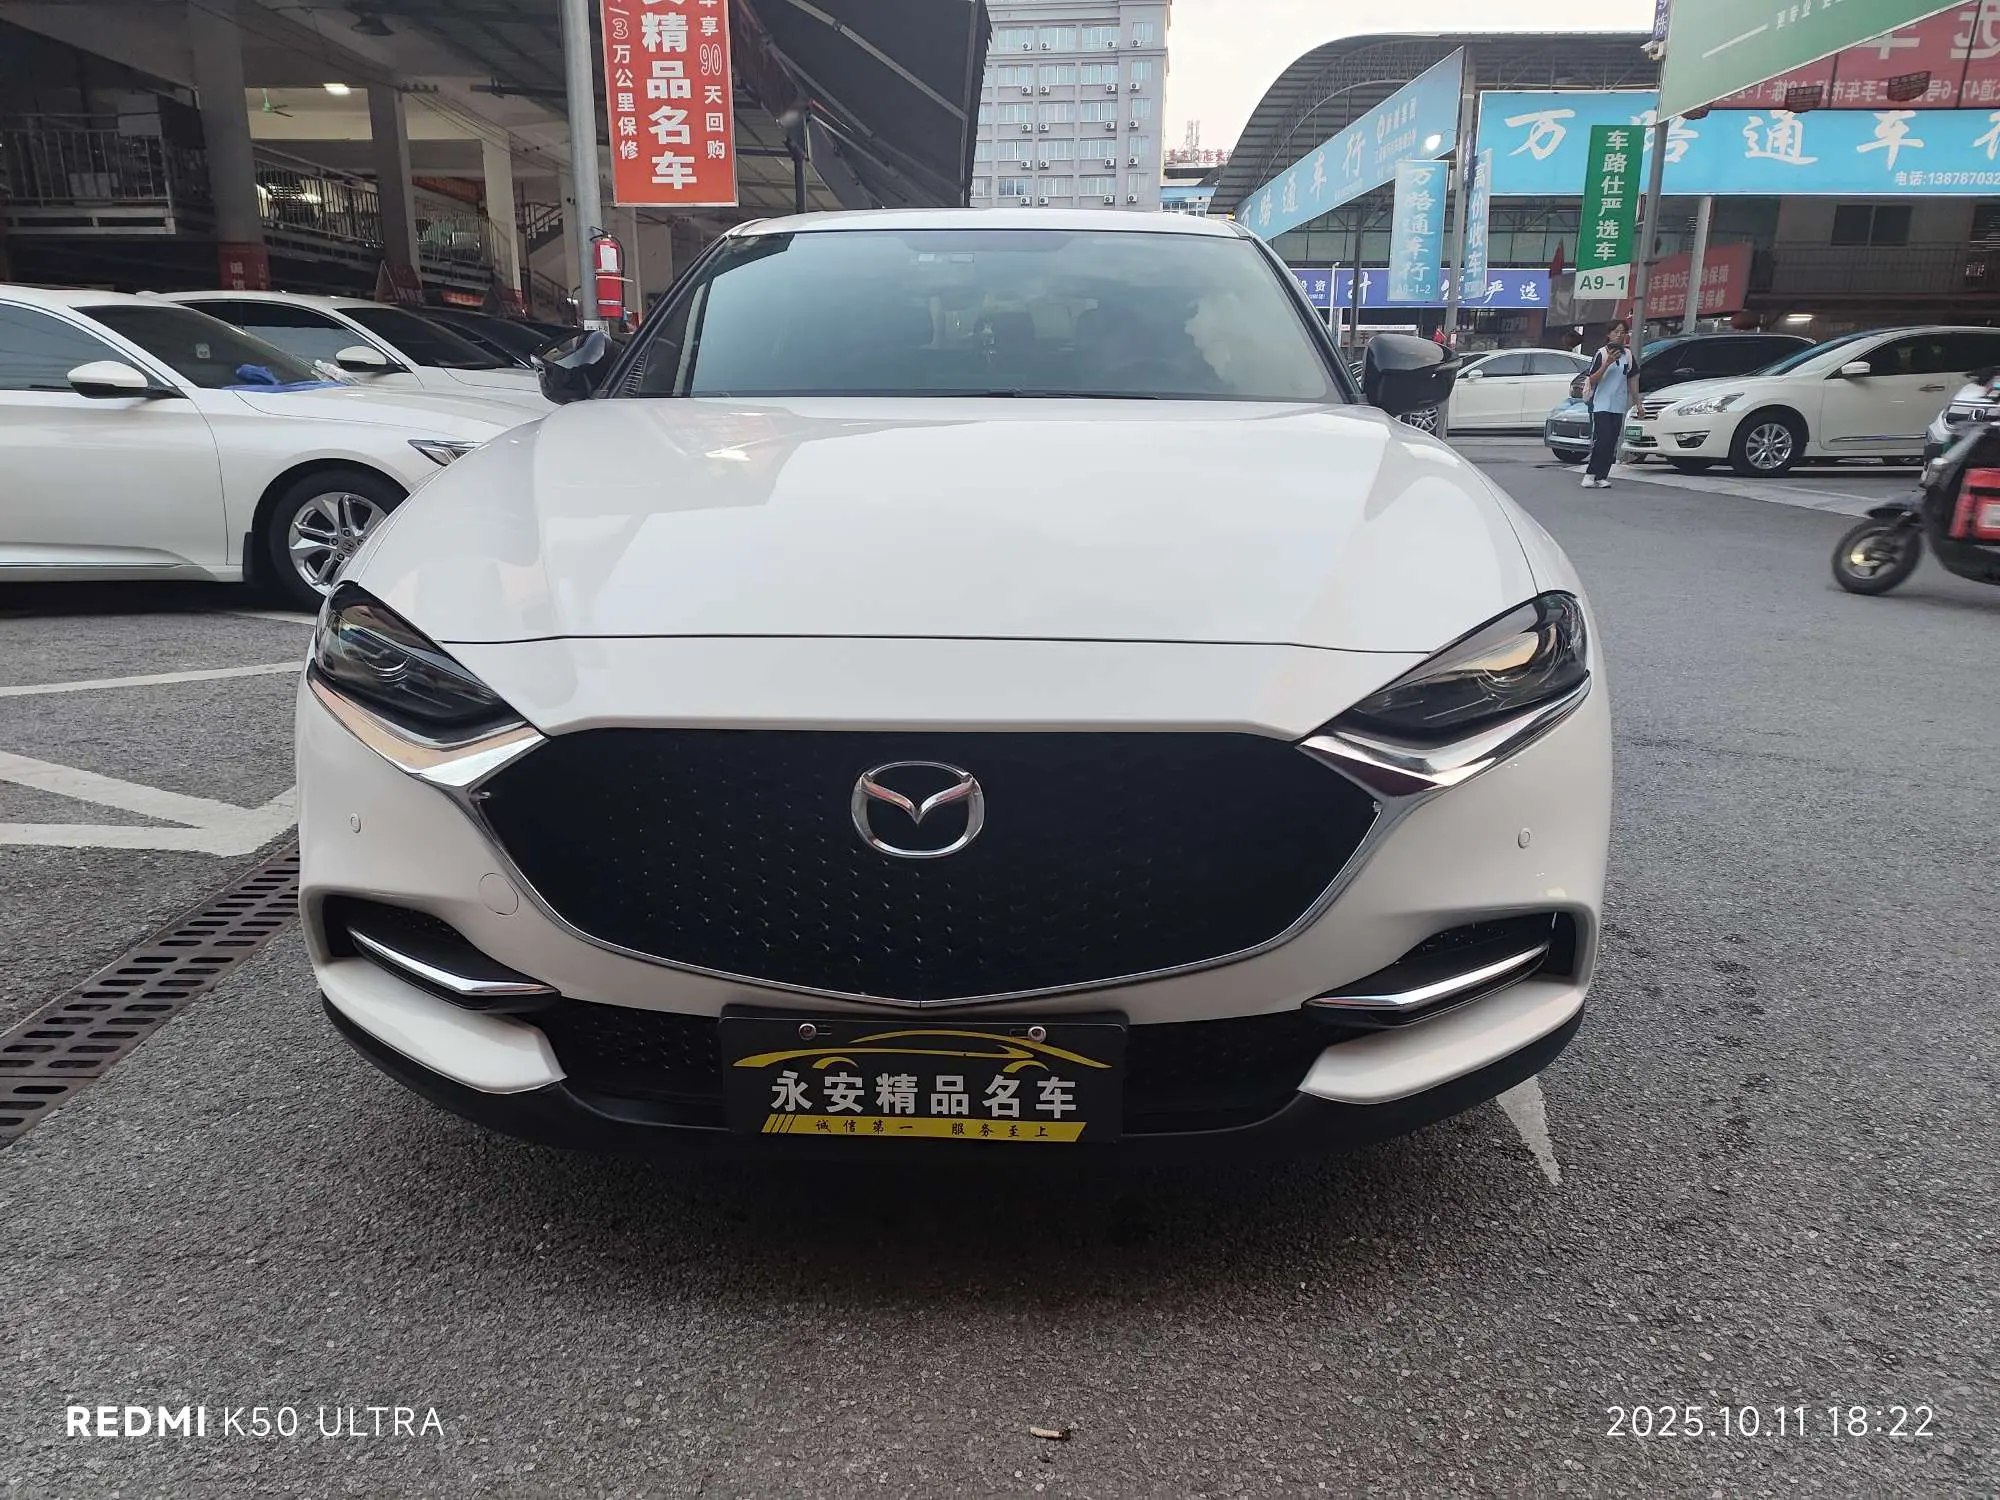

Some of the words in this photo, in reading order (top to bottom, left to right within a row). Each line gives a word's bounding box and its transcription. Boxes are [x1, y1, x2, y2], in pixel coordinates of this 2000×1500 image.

[640, 0, 698, 190] 精品名车
[1594, 130, 1629, 261] 车路仕严选车
[1580, 275, 1625, 290] A9-1
[771, 1070, 1077, 1119] 永安精品名车
[816, 1119, 914, 1134] 诚信第一
[951, 1122, 1049, 1138] 服务至上
